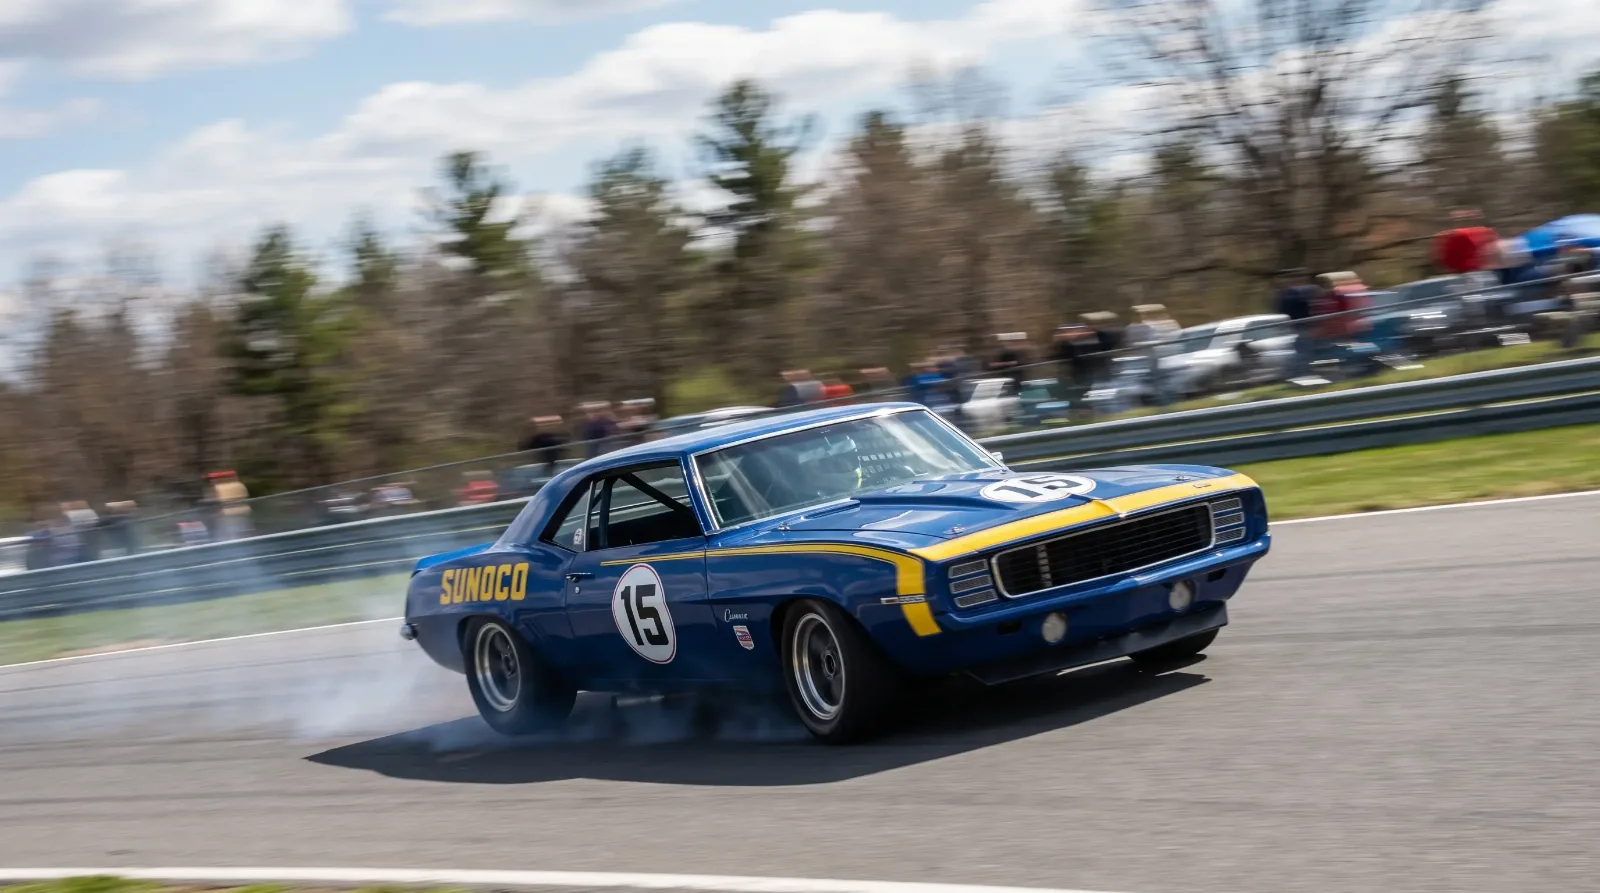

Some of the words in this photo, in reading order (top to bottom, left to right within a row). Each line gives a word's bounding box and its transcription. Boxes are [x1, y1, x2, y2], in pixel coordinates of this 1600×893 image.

[993, 476, 1083, 498] 15
[440, 563, 529, 605] SUNOCO
[621, 584, 669, 646] 15
